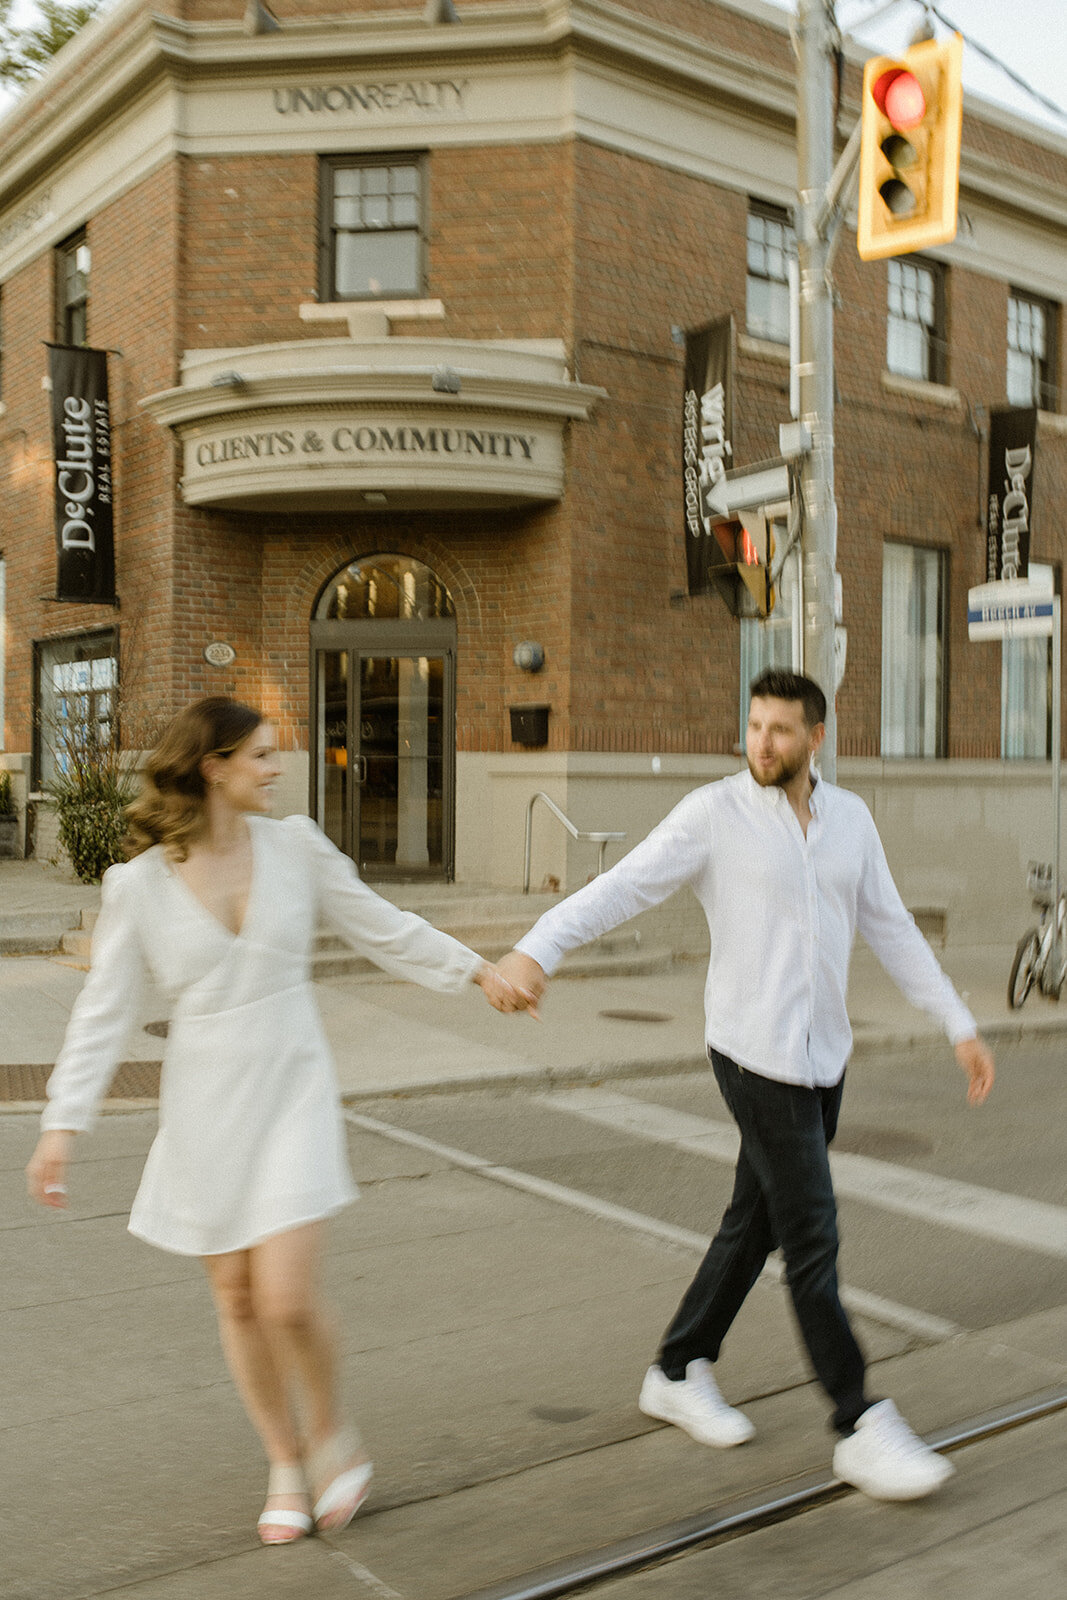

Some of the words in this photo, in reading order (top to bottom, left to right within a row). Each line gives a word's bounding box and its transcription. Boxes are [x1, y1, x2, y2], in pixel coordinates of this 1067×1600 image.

[94, 400, 111, 457] ESTATE
[197, 430, 294, 467] CLIENTS
[300, 430, 324, 453] &
[331, 427, 535, 459] COMMUNITY
[684, 389, 698, 467] SISTERS
[98, 464, 111, 504] REAL
[685, 467, 700, 538] GROUP
